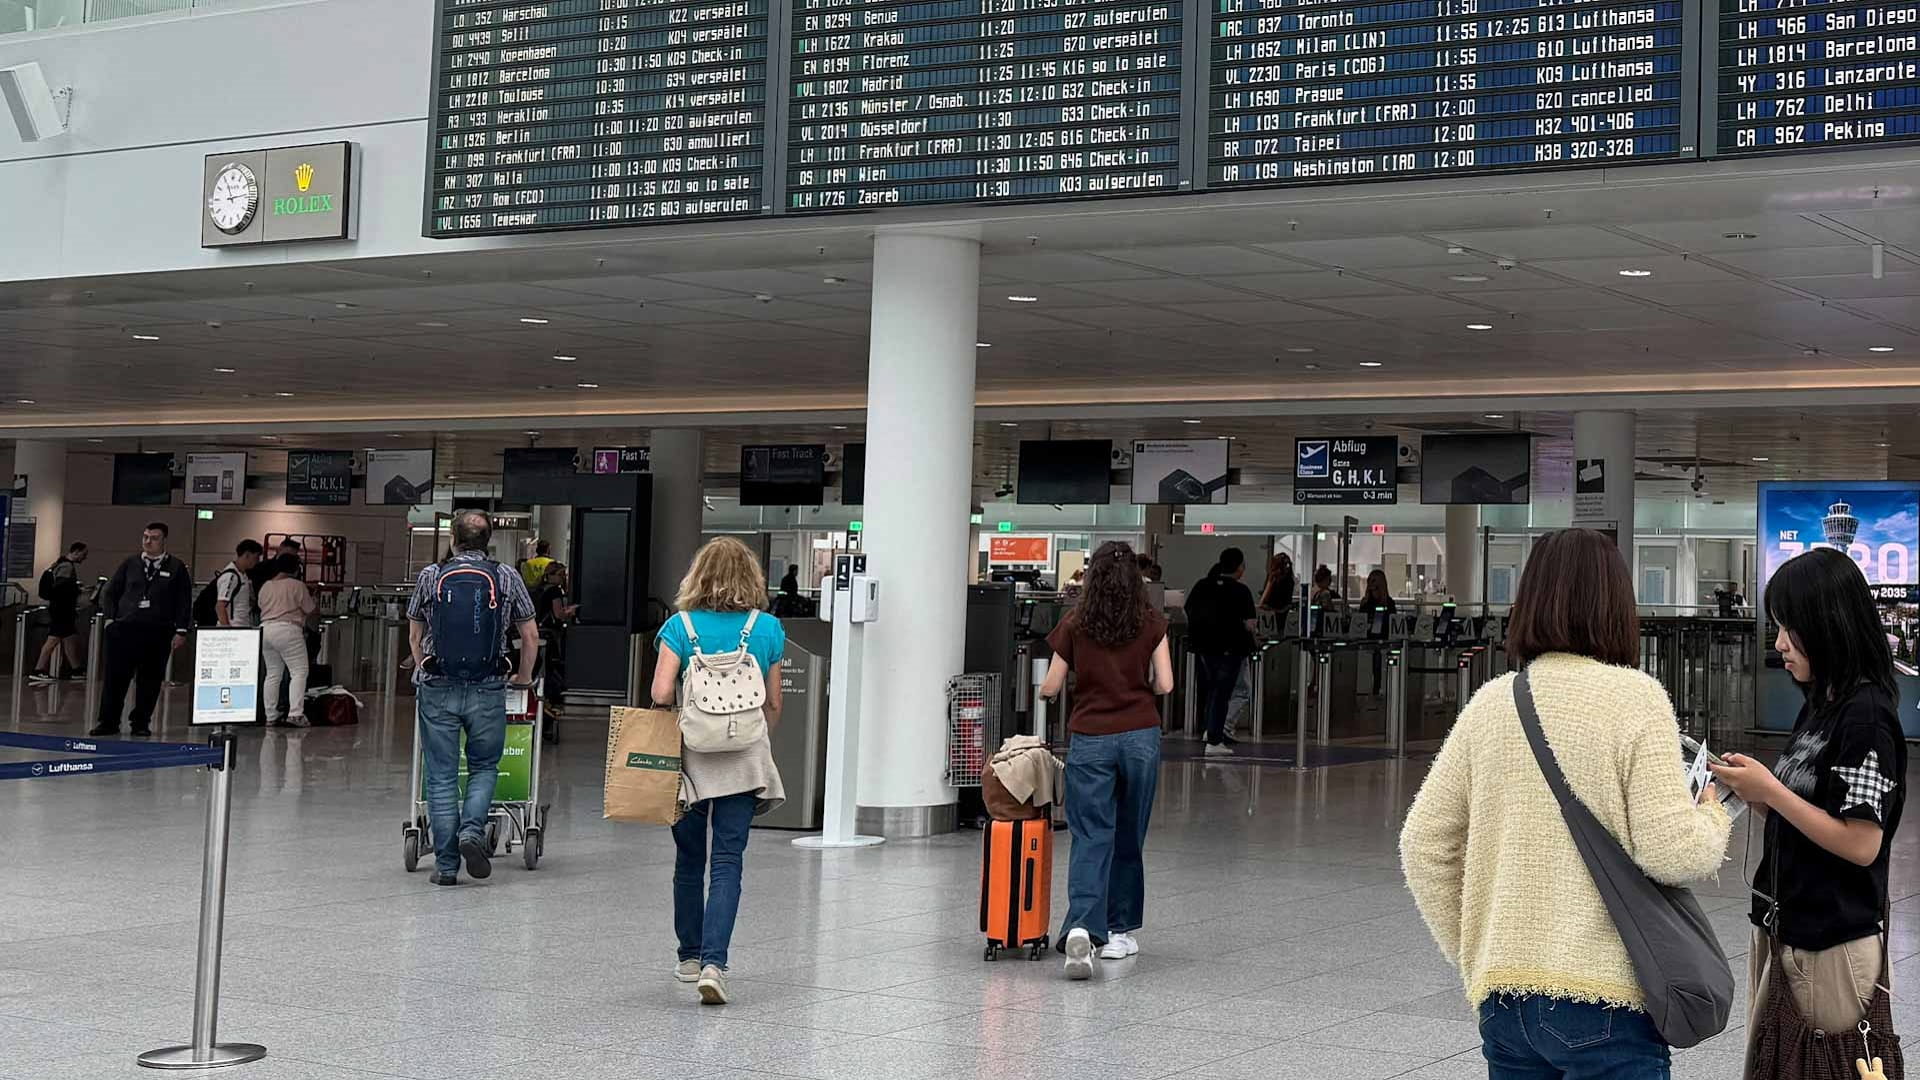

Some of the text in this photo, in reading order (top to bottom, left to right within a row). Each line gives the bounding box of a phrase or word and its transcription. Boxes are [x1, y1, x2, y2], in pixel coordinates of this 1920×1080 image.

[1226, 44, 1242, 61] LH
[1250, 40, 1280, 59] 1852
[1296, 37, 1337, 54] Milan
[1436, 21, 1477, 42] 11:55
[1487, 16, 1529, 38] 12:25
[1573, 8, 1654, 30] Lufthansa
[1227, 19, 1242, 36] AC
[1257, 15, 1281, 34] 837
[1297, 9, 1353, 30] Toronto
[1738, 7, 1916, 40] LH 466 San Diego
[1225, 68, 1241, 85] VL
[1248, 64, 1280, 83] 2230
[1295, 60, 1336, 79] Paris
[1436, 47, 1476, 67] 11:55
[1572, 34, 1654, 55] Lufthansa
[1737, 35, 1916, 67] LH 1814 Barcelona
[1224, 61, 1653, 109] LH 1690 Prague 11:55 K09 Lufthansa
[1737, 61, 1915, 93] 4Y 316 Lanzarote
[1224, 116, 1240, 133] LH
[1256, 112, 1279, 131] 103
[1294, 106, 1365, 128] Frankfurt
[1434, 98, 1475, 118] 12:00
[1571, 84, 1652, 107] cancelled
[1737, 92, 1873, 120] LH 762 Delhi
[1223, 111, 1634, 157] BR 072 Taipei 12:00 H32 401-406
[1736, 120, 1884, 147] CA 962 Peking
[1223, 164, 1239, 181] UA
[1255, 162, 1278, 179] 109
[1293, 157, 1374, 177] Washington
[1433, 149, 1474, 168] 12:00
[1534, 142, 1561, 162] H38
[1570, 138, 1633, 159] 320-328
[274, 194, 334, 216] ROLEX
[621, 450, 638, 461] Fast
[1333, 440, 1367, 455] Abflug
[1333, 469, 1387, 486] G, H, K, L
[1363, 491, 1393, 500] 0-3 min
[1780, 530, 1798, 540] NET
[1779, 541, 1909, 585] ZRO
[1880, 587, 1907, 598] 2035
[72, 741, 97, 751] Lufthansa
[48, 762, 94, 773] Lufthansa
